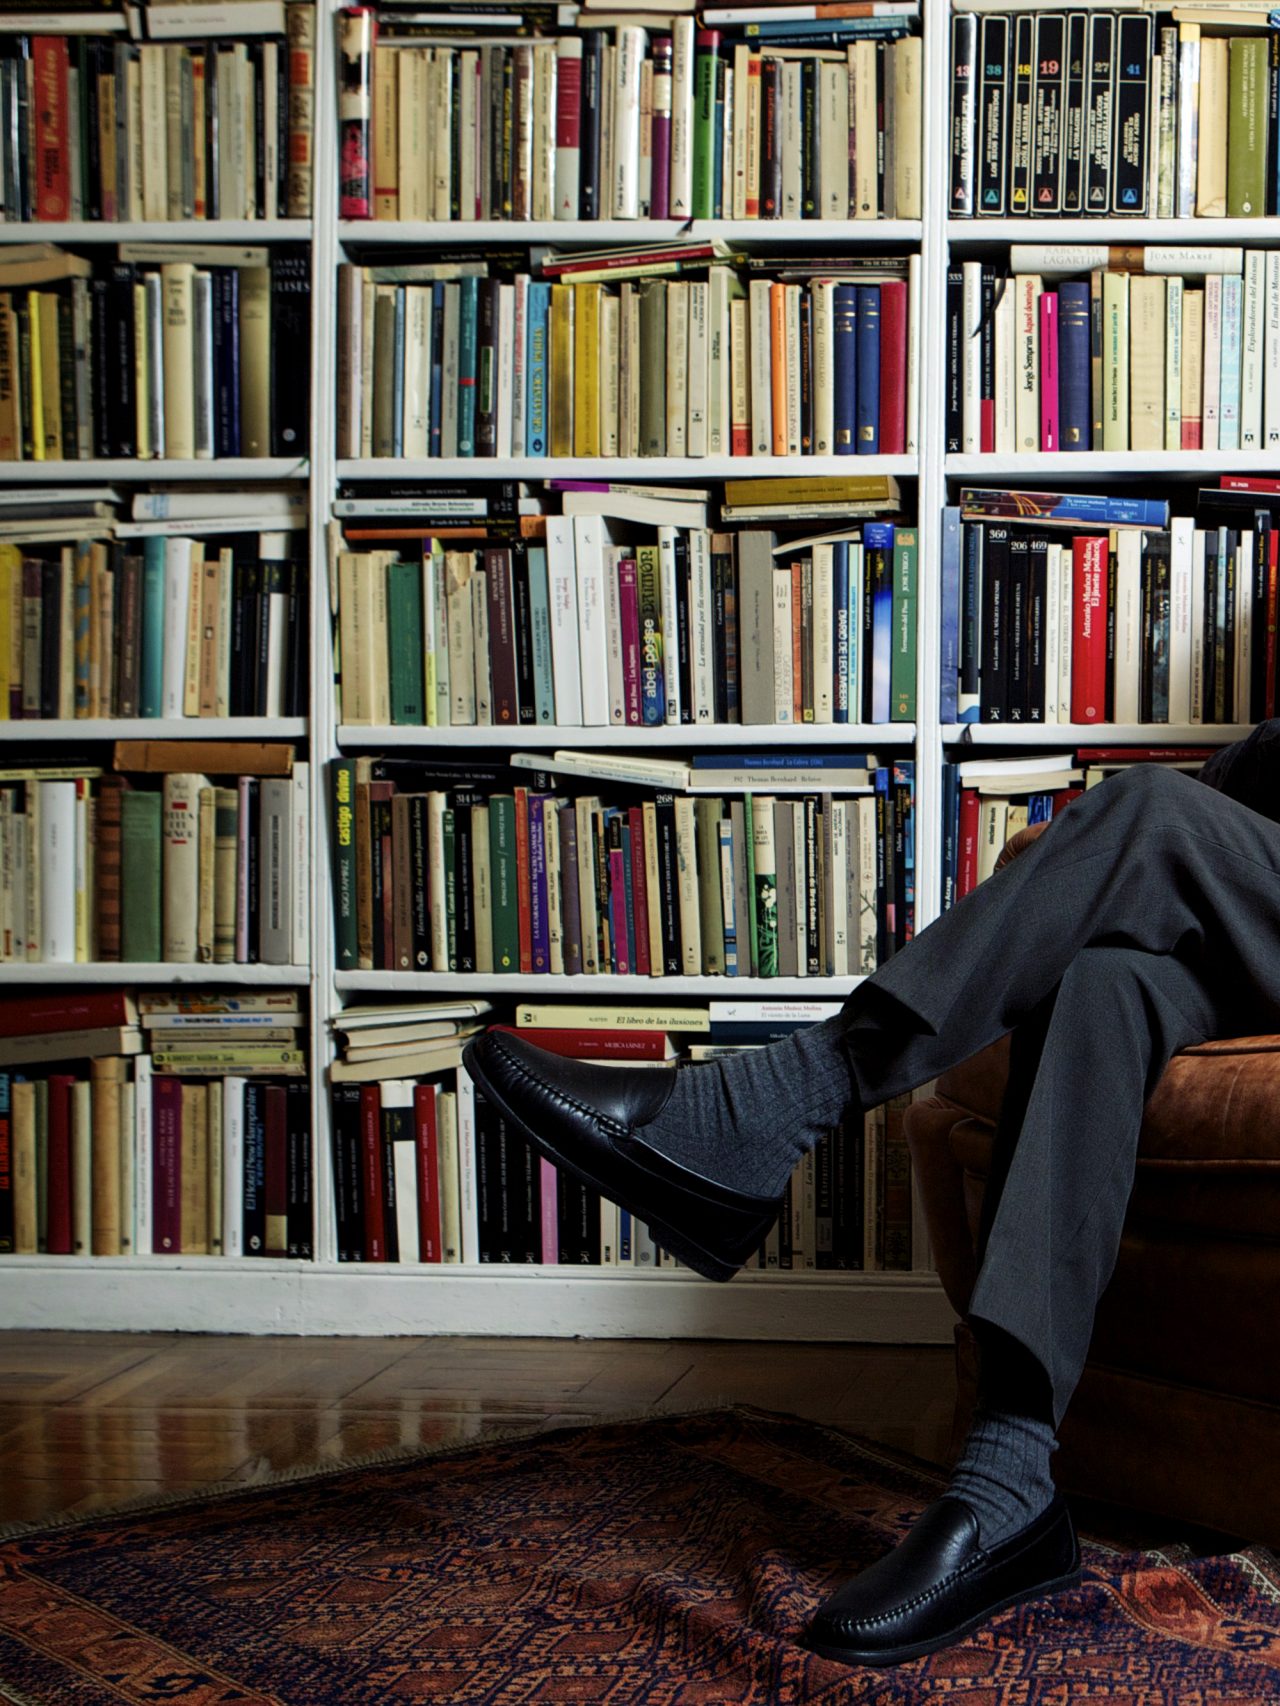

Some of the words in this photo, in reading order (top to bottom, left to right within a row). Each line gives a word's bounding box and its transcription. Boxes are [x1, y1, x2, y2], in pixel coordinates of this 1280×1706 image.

[986, 64, 1002, 75] 38
[1040, 60, 1058, 74] 19
[1094, 62, 1108, 72] 27
[1126, 64, 1140, 74] 41
[1249, 256, 1258, 284] abismo
[1272, 256, 1280, 290] Montano
[1024, 281, 1035, 311] domingo
[1248, 286, 1257, 298] del
[1272, 293, 1279, 301] de
[1025, 314, 1034, 334] Aquel
[1247, 300, 1257, 353] Exploradores
[1272, 320, 1279, 329] El
[1024, 371, 1035, 392] Jorge
[989, 528, 1007, 540] 360
[1011, 542, 1028, 551] 206
[1092, 542, 1101, 571] polaco
[1082, 573, 1091, 602] Muñoz
[1092, 573, 1101, 596] jinete
[1092, 598, 1099, 607] El
[1083, 603, 1092, 638] Antonio
[643, 619, 656, 663] posse
[644, 664, 657, 698] abel
[337, 769, 350, 803] divino
[337, 807, 352, 846] castigo
